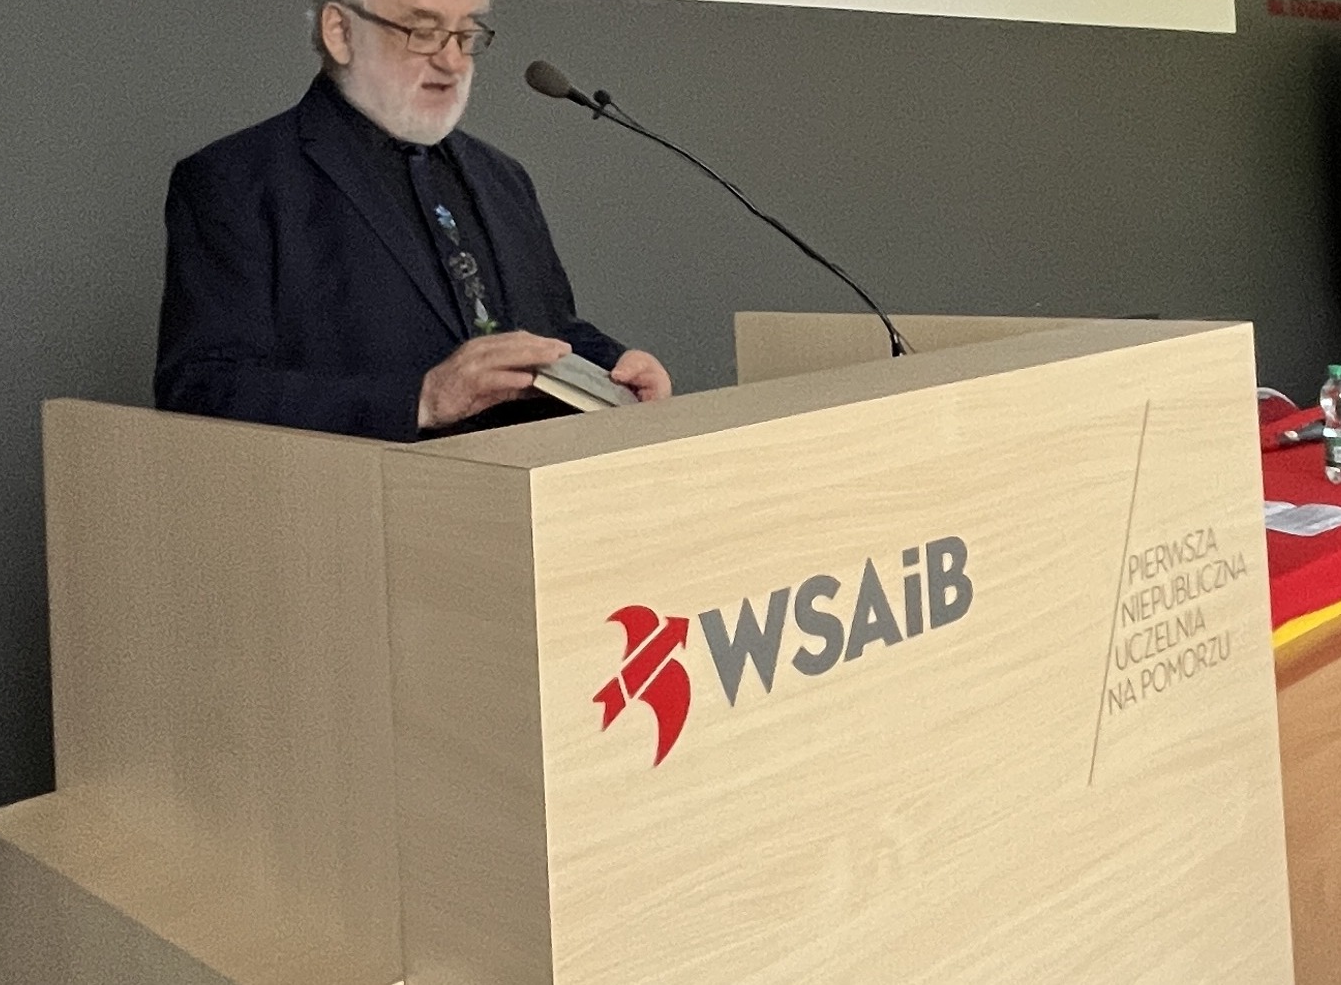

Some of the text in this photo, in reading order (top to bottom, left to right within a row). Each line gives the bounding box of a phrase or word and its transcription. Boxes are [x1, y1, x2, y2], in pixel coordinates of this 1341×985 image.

[1121, 551, 1248, 628] NIEPUBLICZNA
[1128, 527, 1219, 585] PIERWSZA
[698, 535, 974, 708] WSAiB
[1115, 606, 1207, 672] UCZELNIA
[1108, 629, 1231, 715] NA POMORZU
